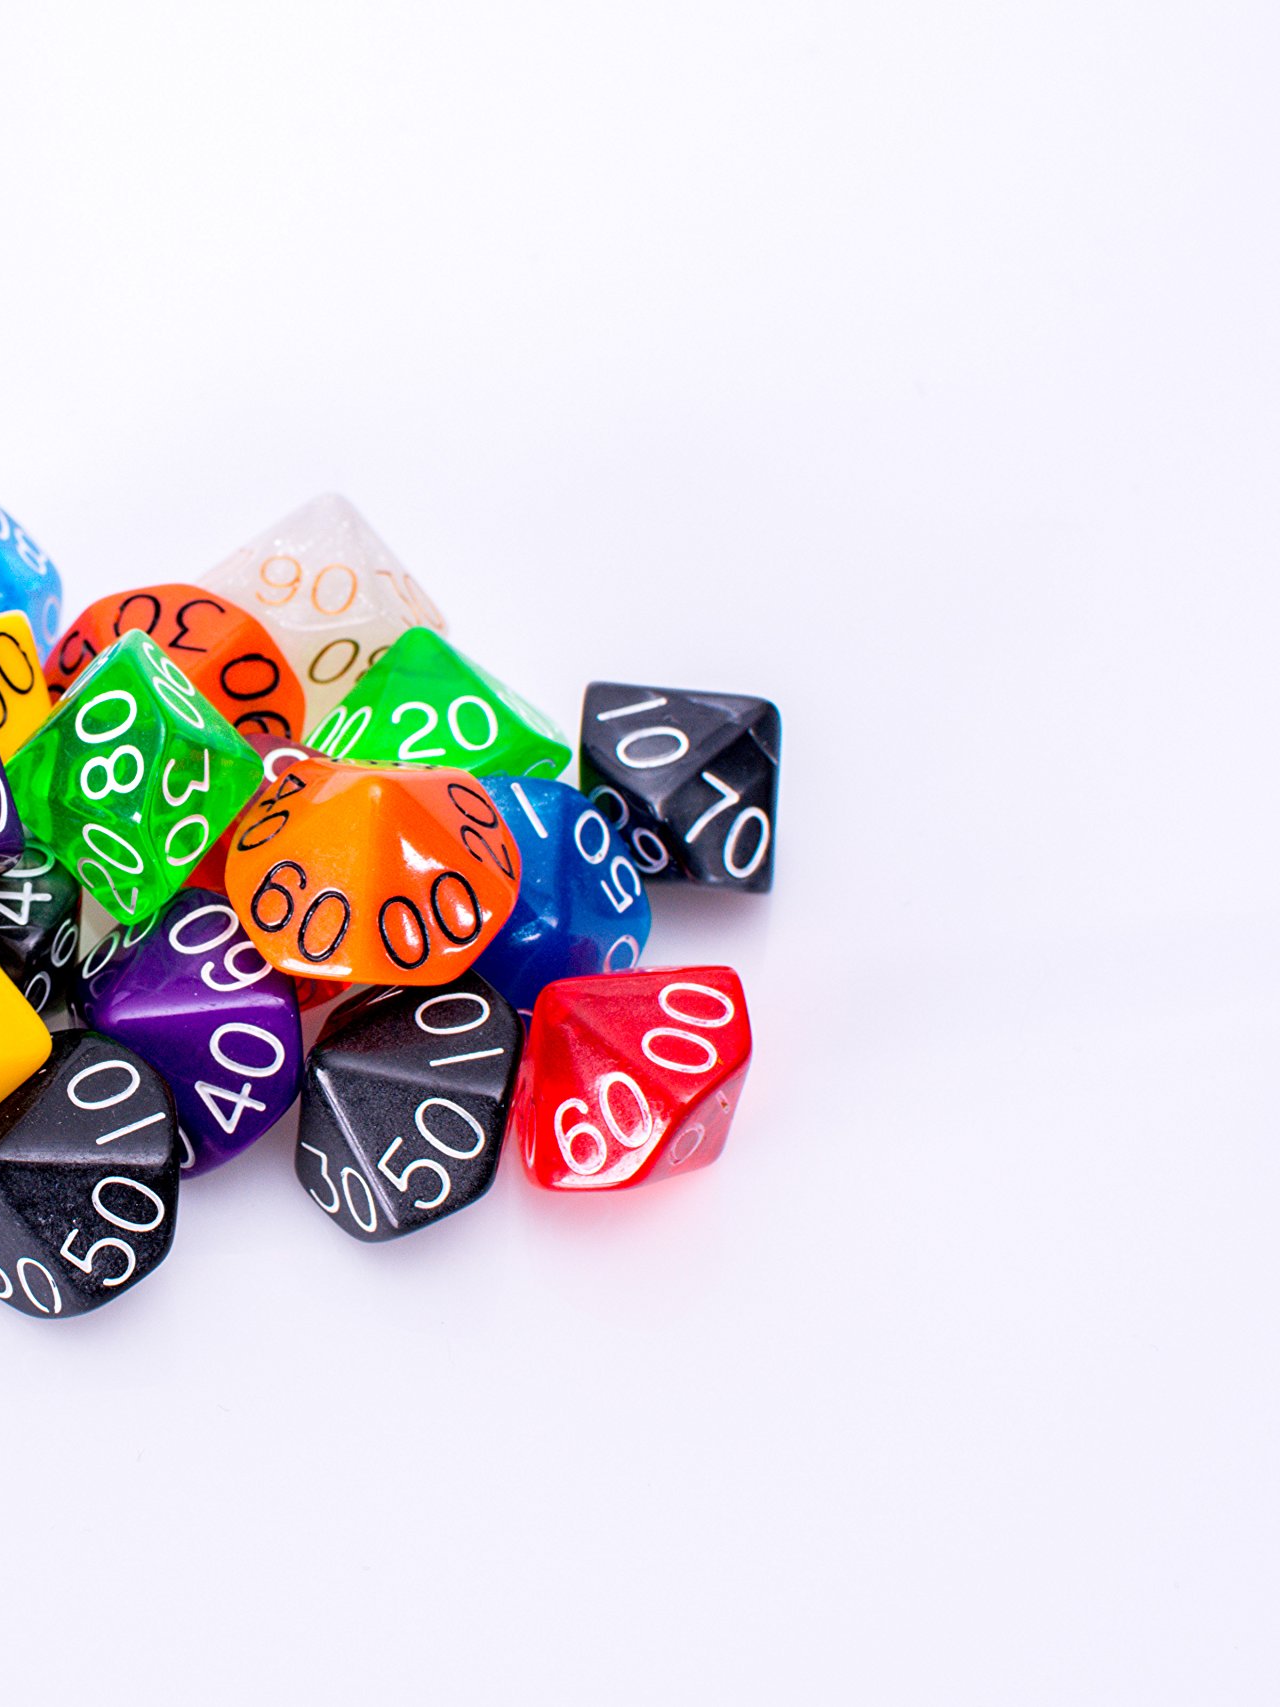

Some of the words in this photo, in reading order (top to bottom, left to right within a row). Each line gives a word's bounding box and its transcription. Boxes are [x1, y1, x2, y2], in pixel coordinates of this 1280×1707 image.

[114, 594, 226, 653] 30
[255, 555, 358, 616] 90
[75, 689, 145, 800] 80
[391, 694, 499, 760] 20
[597, 697, 690, 769] 10
[162, 748, 210, 866] 30
[237, 773, 307, 852] 40
[447, 783, 517, 881] 20
[683, 771, 770, 879] 70
[77, 823, 145, 915] 20
[573, 808, 642, 914] 50
[169, 904, 274, 992] 60
[251, 860, 351, 963] 60
[378, 871, 484, 971] 00
[414, 992, 505, 1067] 10
[641, 982, 736, 1075] 00
[67, 1059, 167, 1145] 10
[194, 1022, 286, 1135] 40
[554, 1071, 653, 1176] 60
[301, 1141, 378, 1233] 30
[377, 1096, 486, 1209] 50
[60, 1176, 165, 1287] 50
